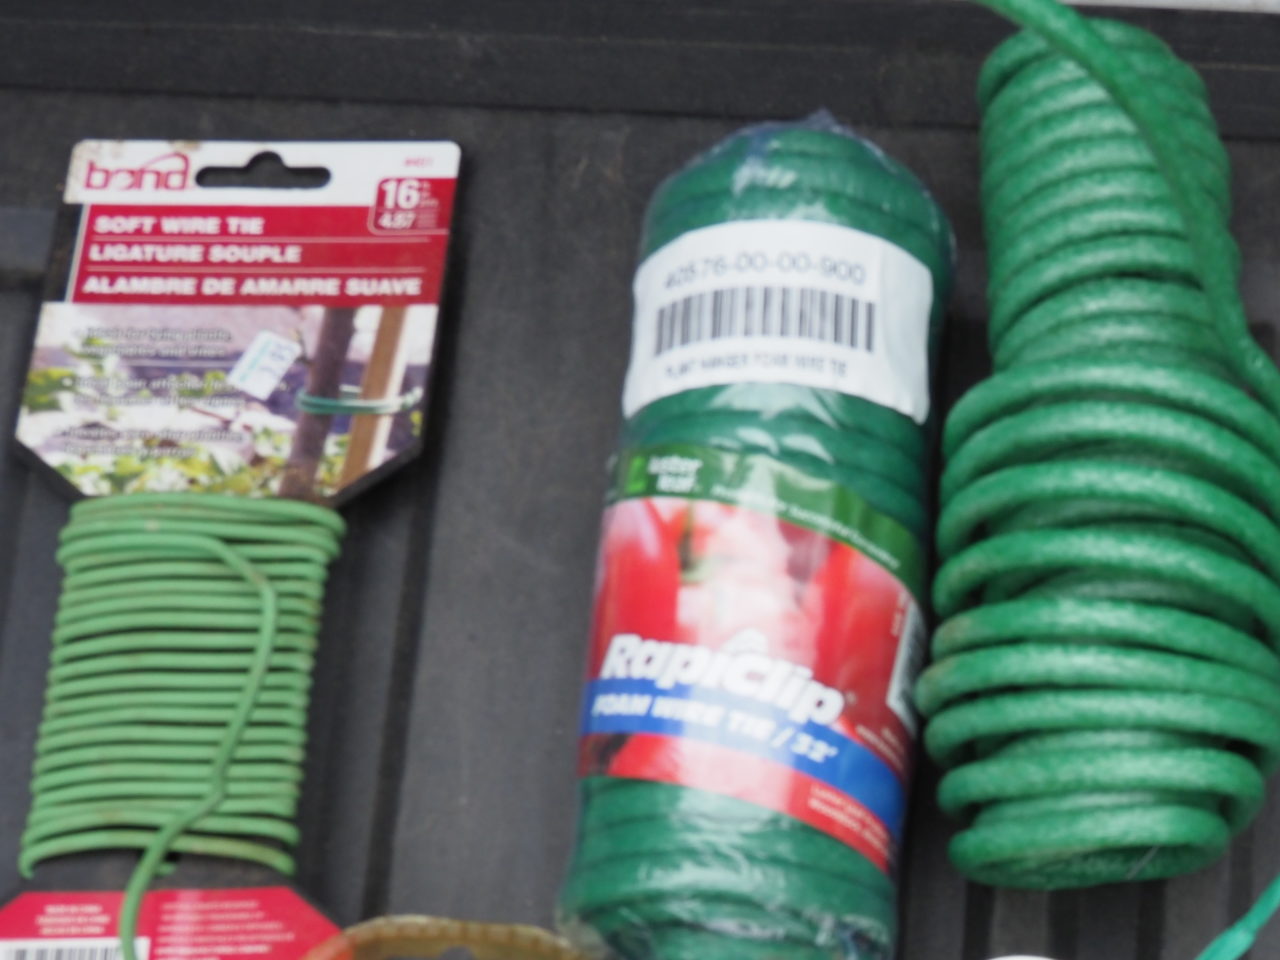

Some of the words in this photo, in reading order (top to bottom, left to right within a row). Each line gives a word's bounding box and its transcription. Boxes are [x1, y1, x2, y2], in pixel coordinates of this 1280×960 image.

[85, 152, 190, 190] bond
[381, 178, 421, 209] 16
[93, 216, 156, 234] SOFT
[161, 216, 221, 235] WIRE
[226, 217, 265, 235] TIE
[88, 243, 204, 262] LIGATURE
[208, 244, 303, 263] SOUPLE
[82, 275, 198, 295] ALAMBRE
[201, 277, 237, 295] DE
[240, 277, 341, 296] AMARRE
[345, 277, 423, 296] SUAVE
[600, 630, 845, 726] RapiClip
[590, 693, 653, 717] FOAM
[651, 695, 726, 727] WIRE
[728, 709, 777, 741] TIE
